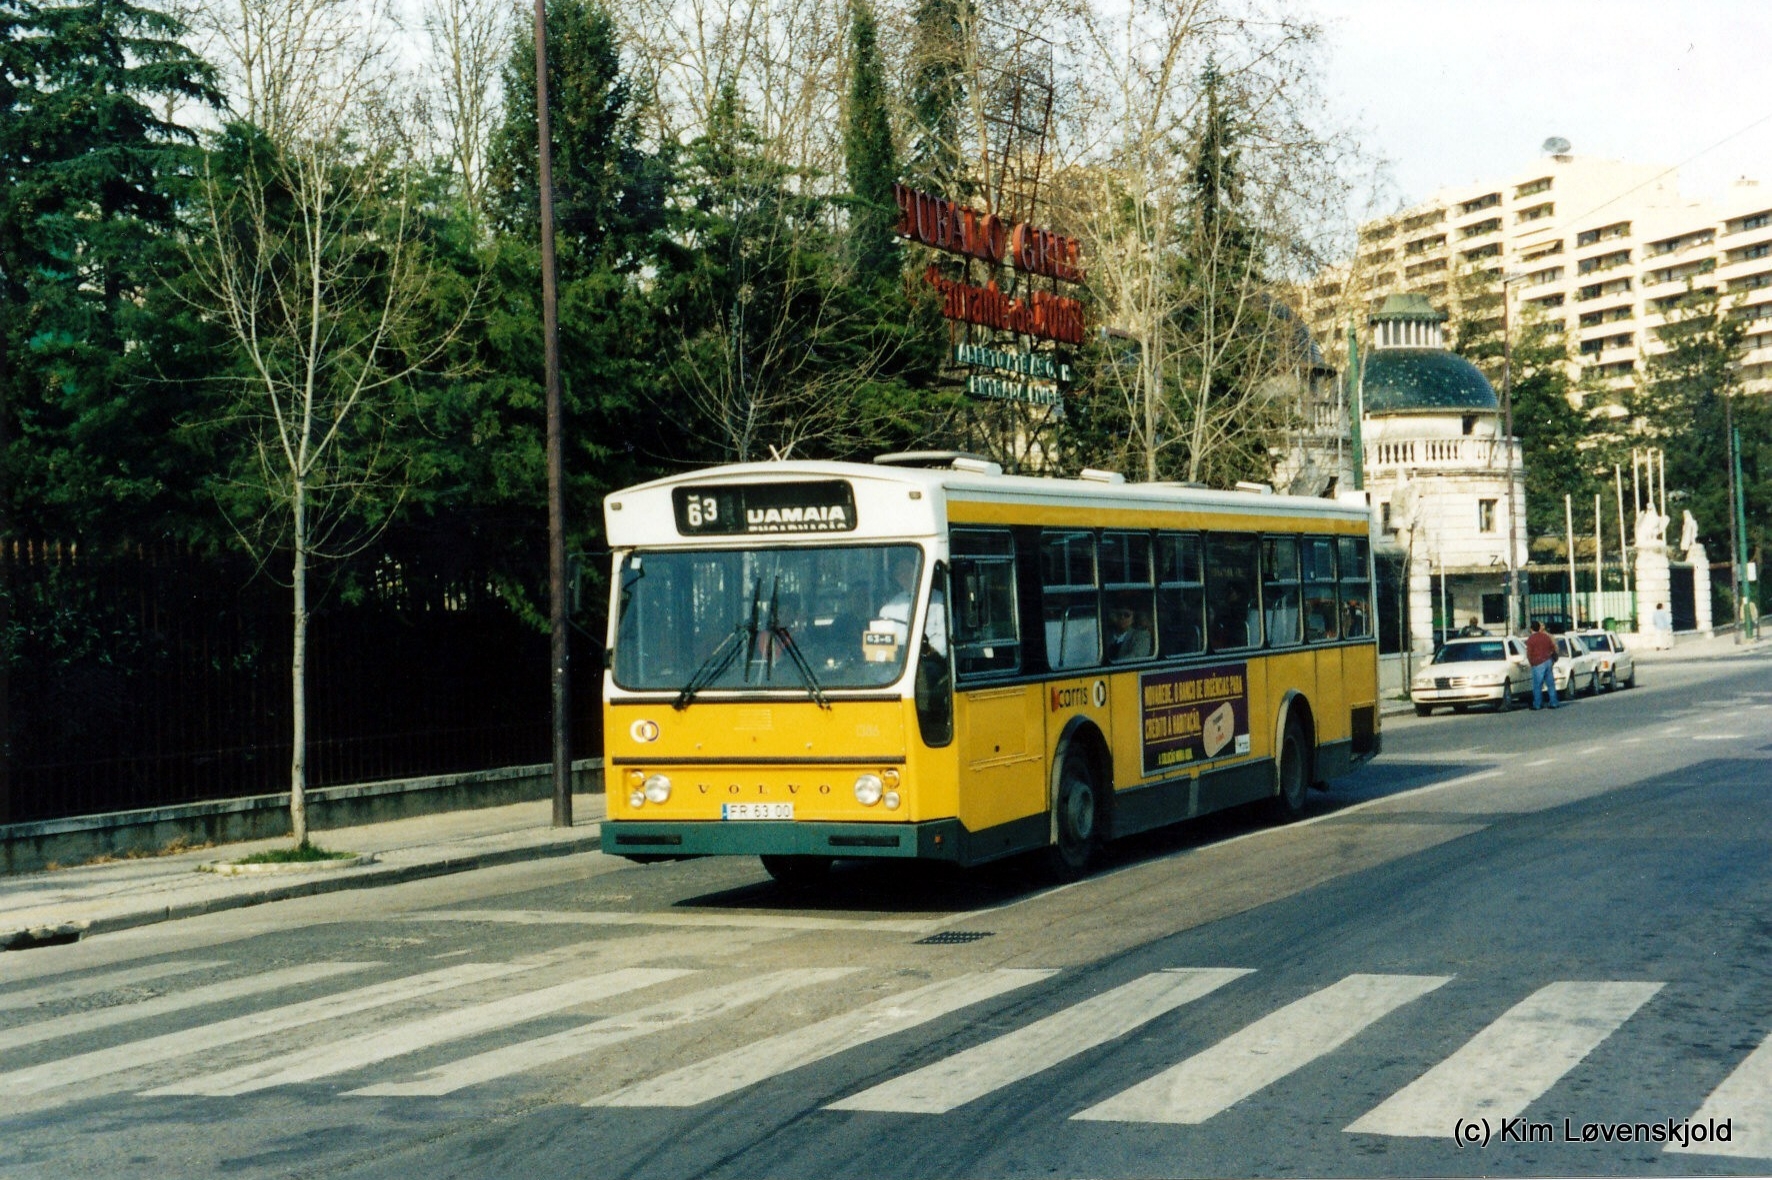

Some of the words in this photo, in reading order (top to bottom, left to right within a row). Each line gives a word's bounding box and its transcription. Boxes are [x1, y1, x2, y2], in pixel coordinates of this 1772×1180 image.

[687, 498, 718, 527] 63
[1058, 687, 1089, 708] carris
[698, 784, 831, 795] VOLVO
[731, 805, 748, 818] FR
[755, 805, 769, 818] 63
[775, 805, 790, 818] 00
